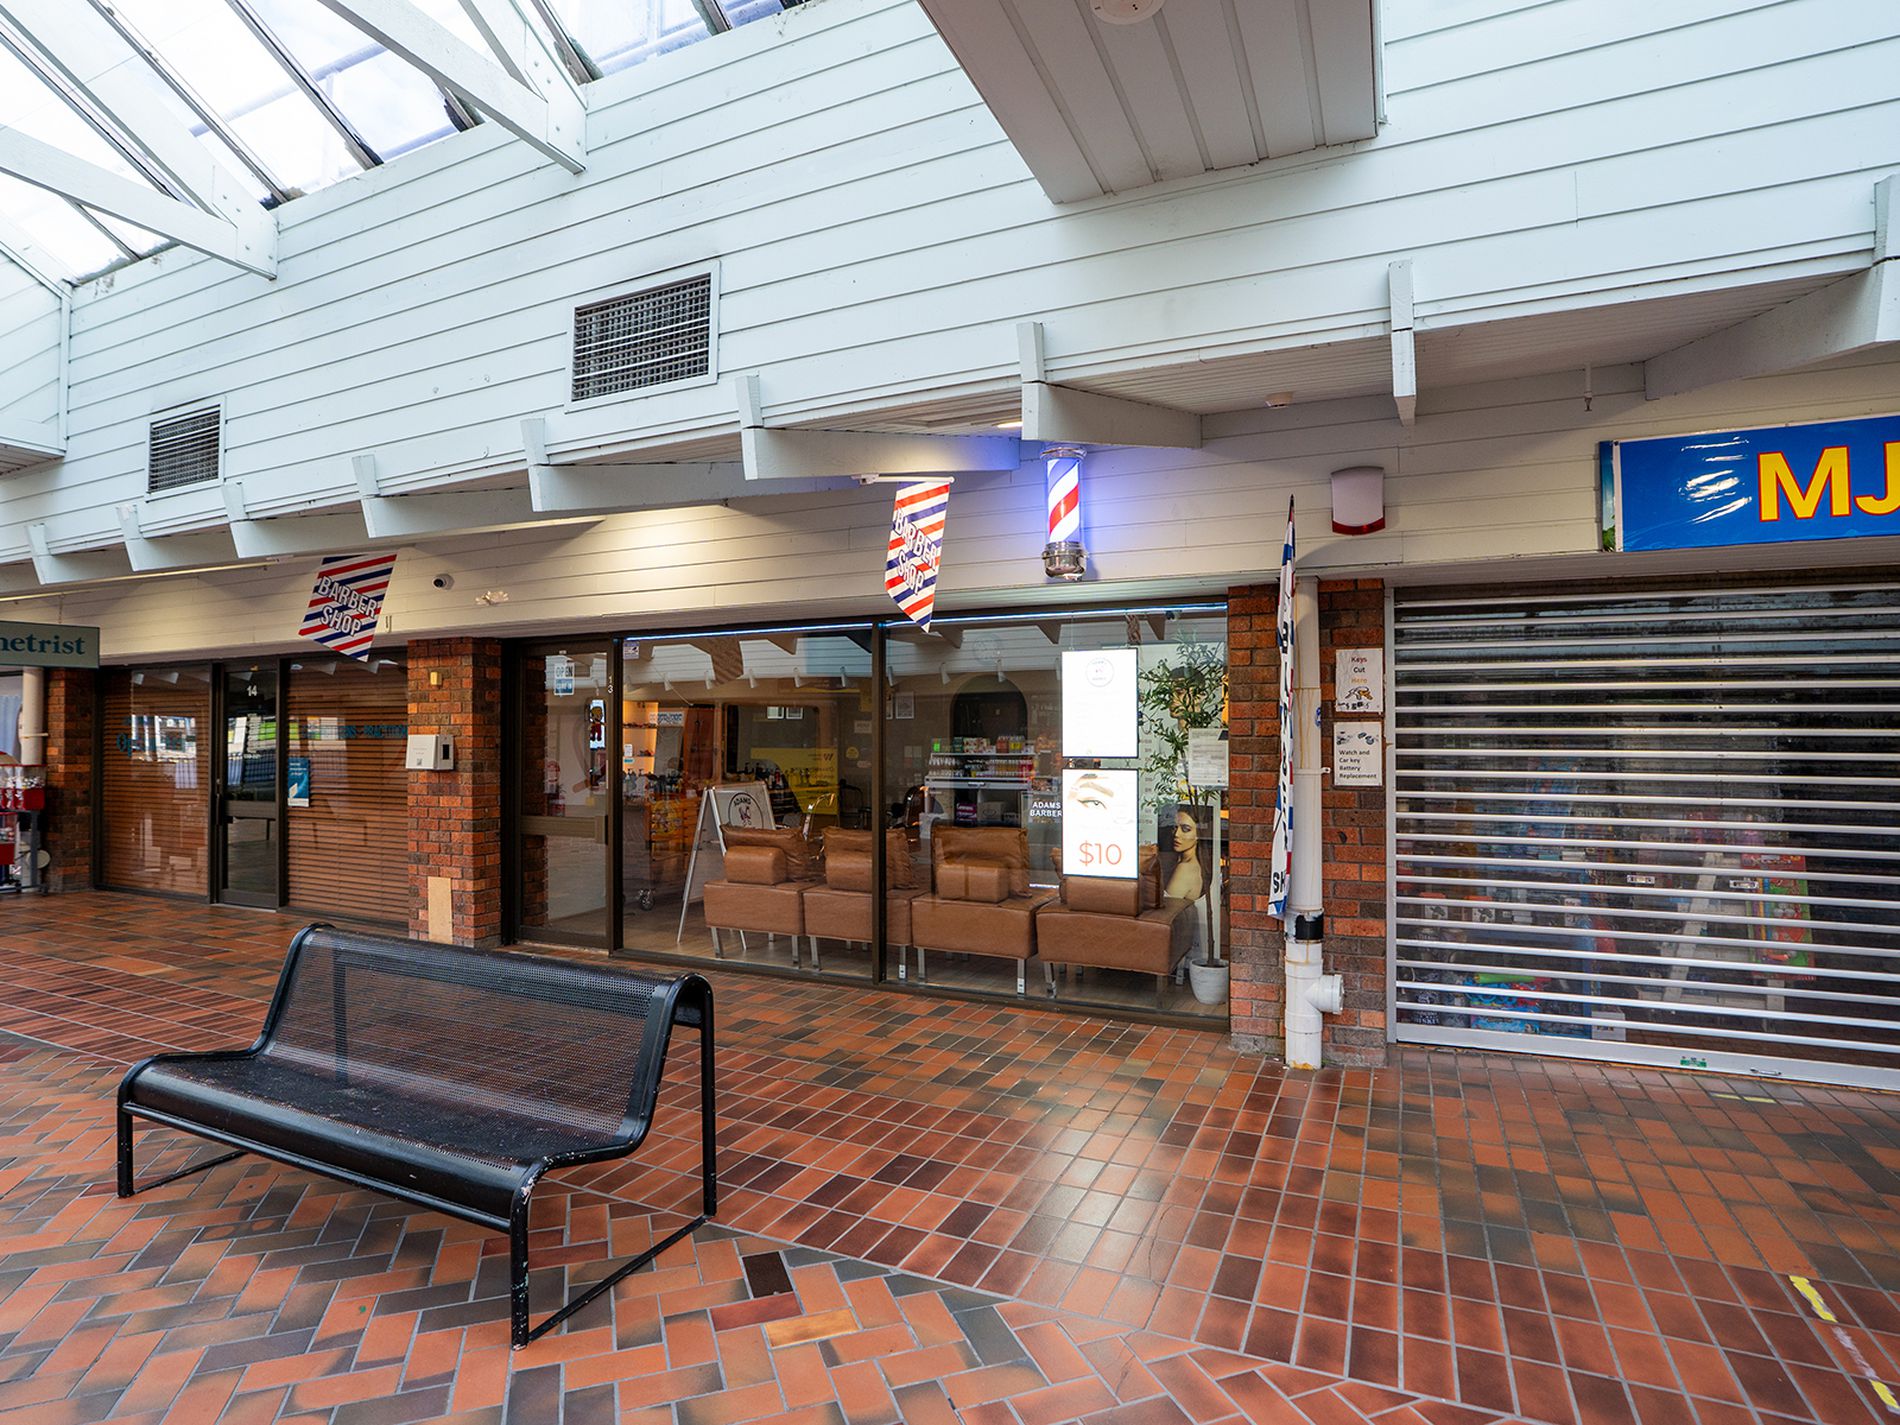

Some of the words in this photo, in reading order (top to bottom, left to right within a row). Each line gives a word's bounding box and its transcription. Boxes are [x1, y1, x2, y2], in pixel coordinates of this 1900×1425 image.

[1757, 441, 1900, 522] MJ
[893, 507, 938, 571] BARBER
[898, 550, 925, 595] SHOP
[317, 575, 378, 620] BARBER
[320, 605, 362, 637] SHOP
[555, 666, 574, 678] OPEN
[1351, 656, 1368, 664] Keys
[246, 685, 258, 697] 14
[1032, 801, 1061, 809] ADAMS
[1079, 840, 1122, 867] $10
